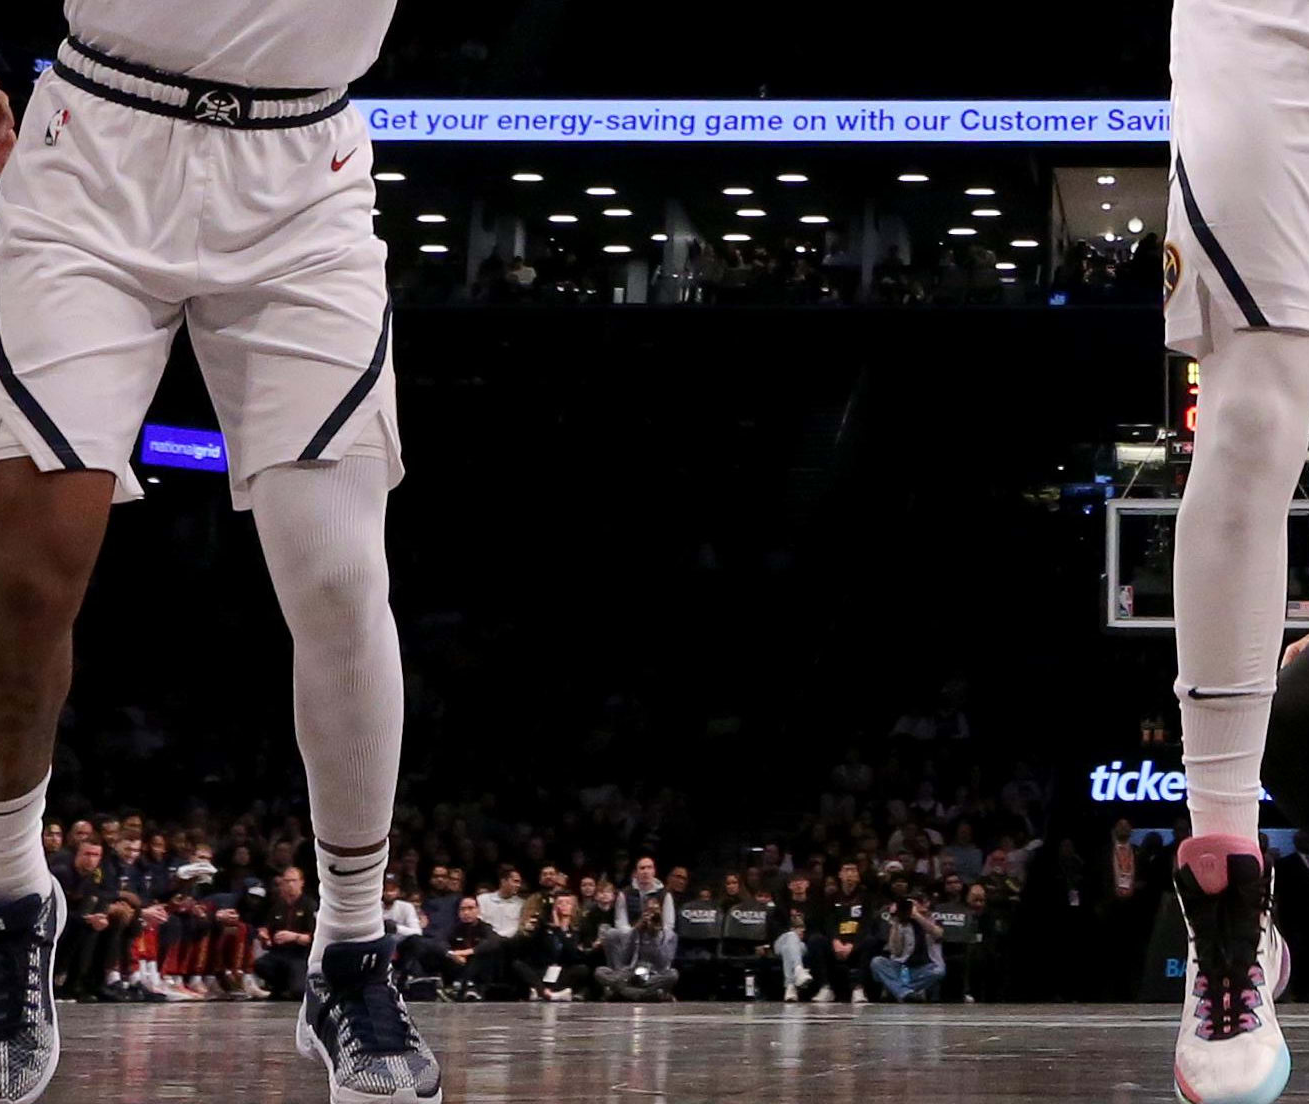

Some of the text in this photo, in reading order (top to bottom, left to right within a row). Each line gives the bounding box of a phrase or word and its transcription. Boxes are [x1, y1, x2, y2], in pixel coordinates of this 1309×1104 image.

[370, 108, 418, 131] Get
[426, 110, 488, 135] your
[497, 108, 695, 135] energy-saving
[705, 113, 784, 135] game
[793, 113, 826, 132] on
[836, 109, 893, 131] with
[904, 113, 950, 131] our
[960, 109, 1098, 132] Customer
